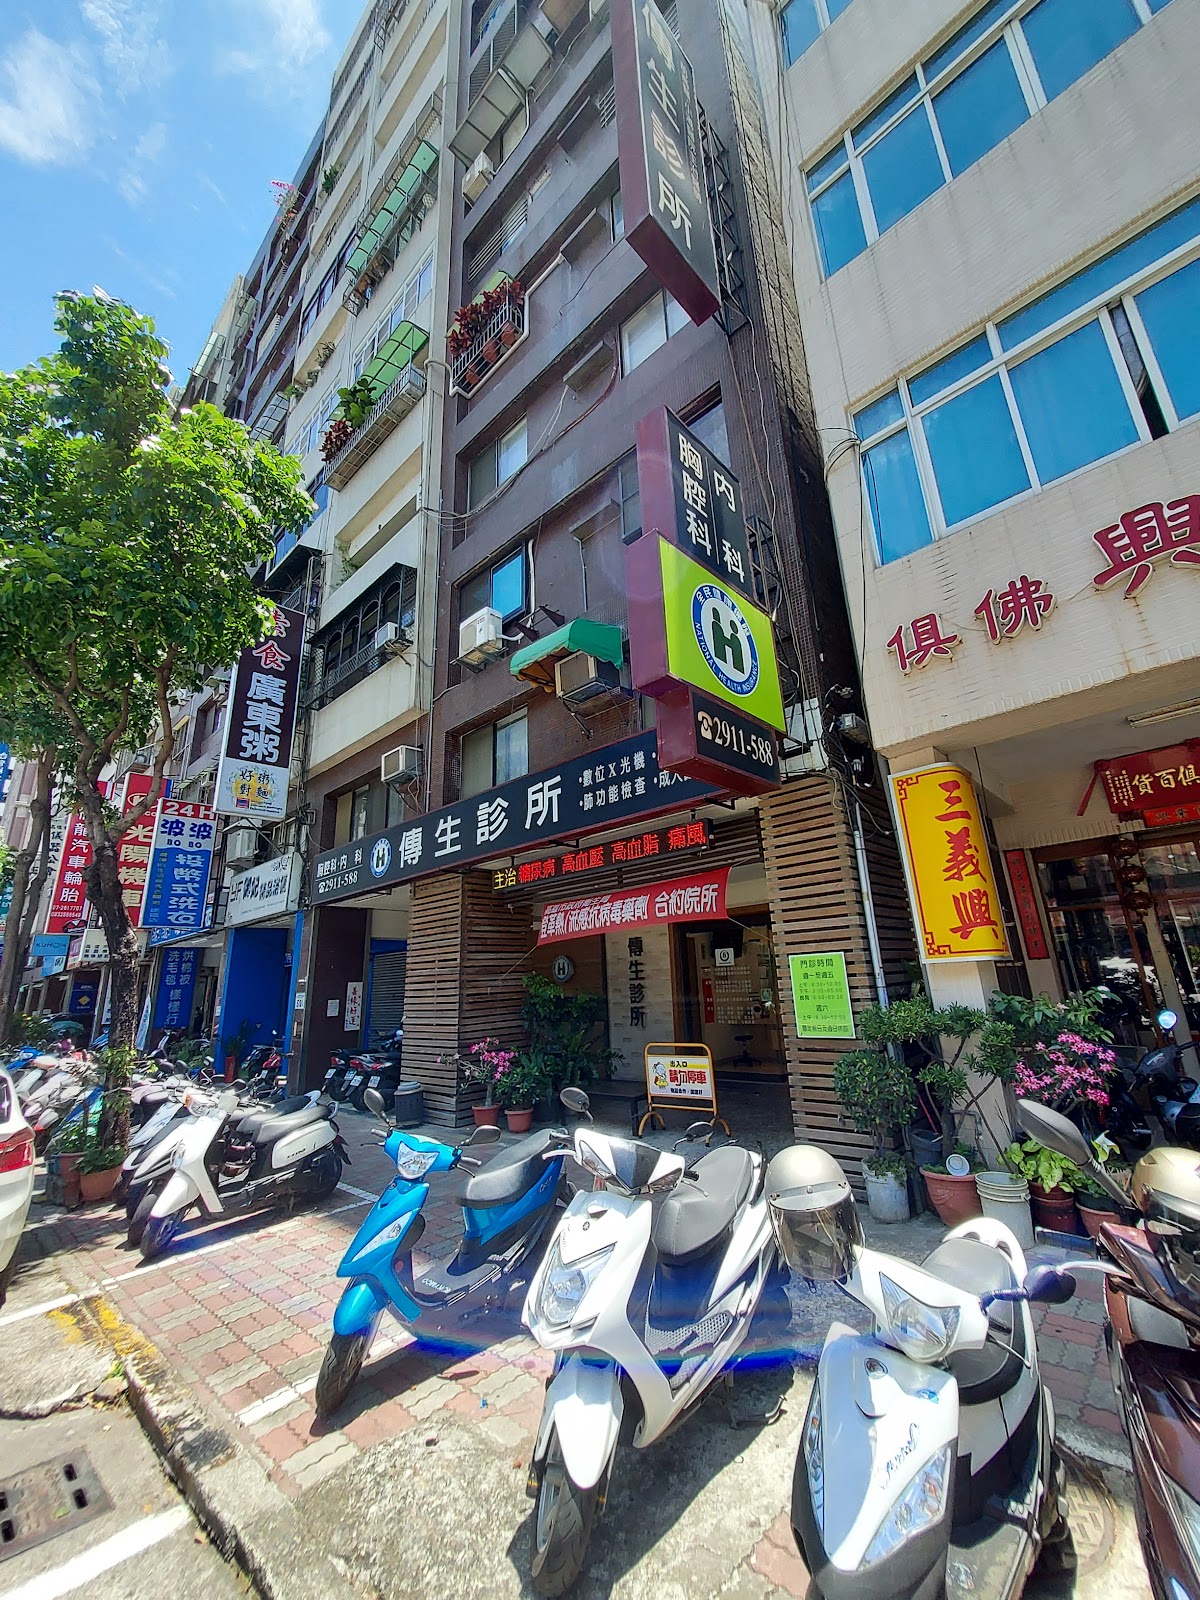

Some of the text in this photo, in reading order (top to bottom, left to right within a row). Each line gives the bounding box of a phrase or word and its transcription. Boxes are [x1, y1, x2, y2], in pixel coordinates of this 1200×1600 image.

[679, 432, 712, 557] 胸腔科
[714, 469, 745, 584] 內科
[695, 621, 716, 673] NATIONAL
[718, 671, 742, 693] HEALTH
[239, 671, 288, 763] 廣東粥
[714, 716, 774, 767] 2911-588
[583, 751, 646, 788] 數位X光機
[583, 777, 647, 812] 肺功能檢查
[160, 818, 214, 841] 波波
[167, 839, 181, 847] BO
[493, 820, 706, 890] 主治 糖尿病 高血壓 高血脂 痛風
[934, 779, 1000, 941] 三義興
[324, 870, 358, 892] 2911-588
[654, 883, 719, 919] 合約院所
[799, 958, 834, 969] 門診時間
[802, 971, 834, 979] 週一至週五
[668, 1069, 707, 1087] 請勿停車
[669, 1060, 688, 1068] 出入口
